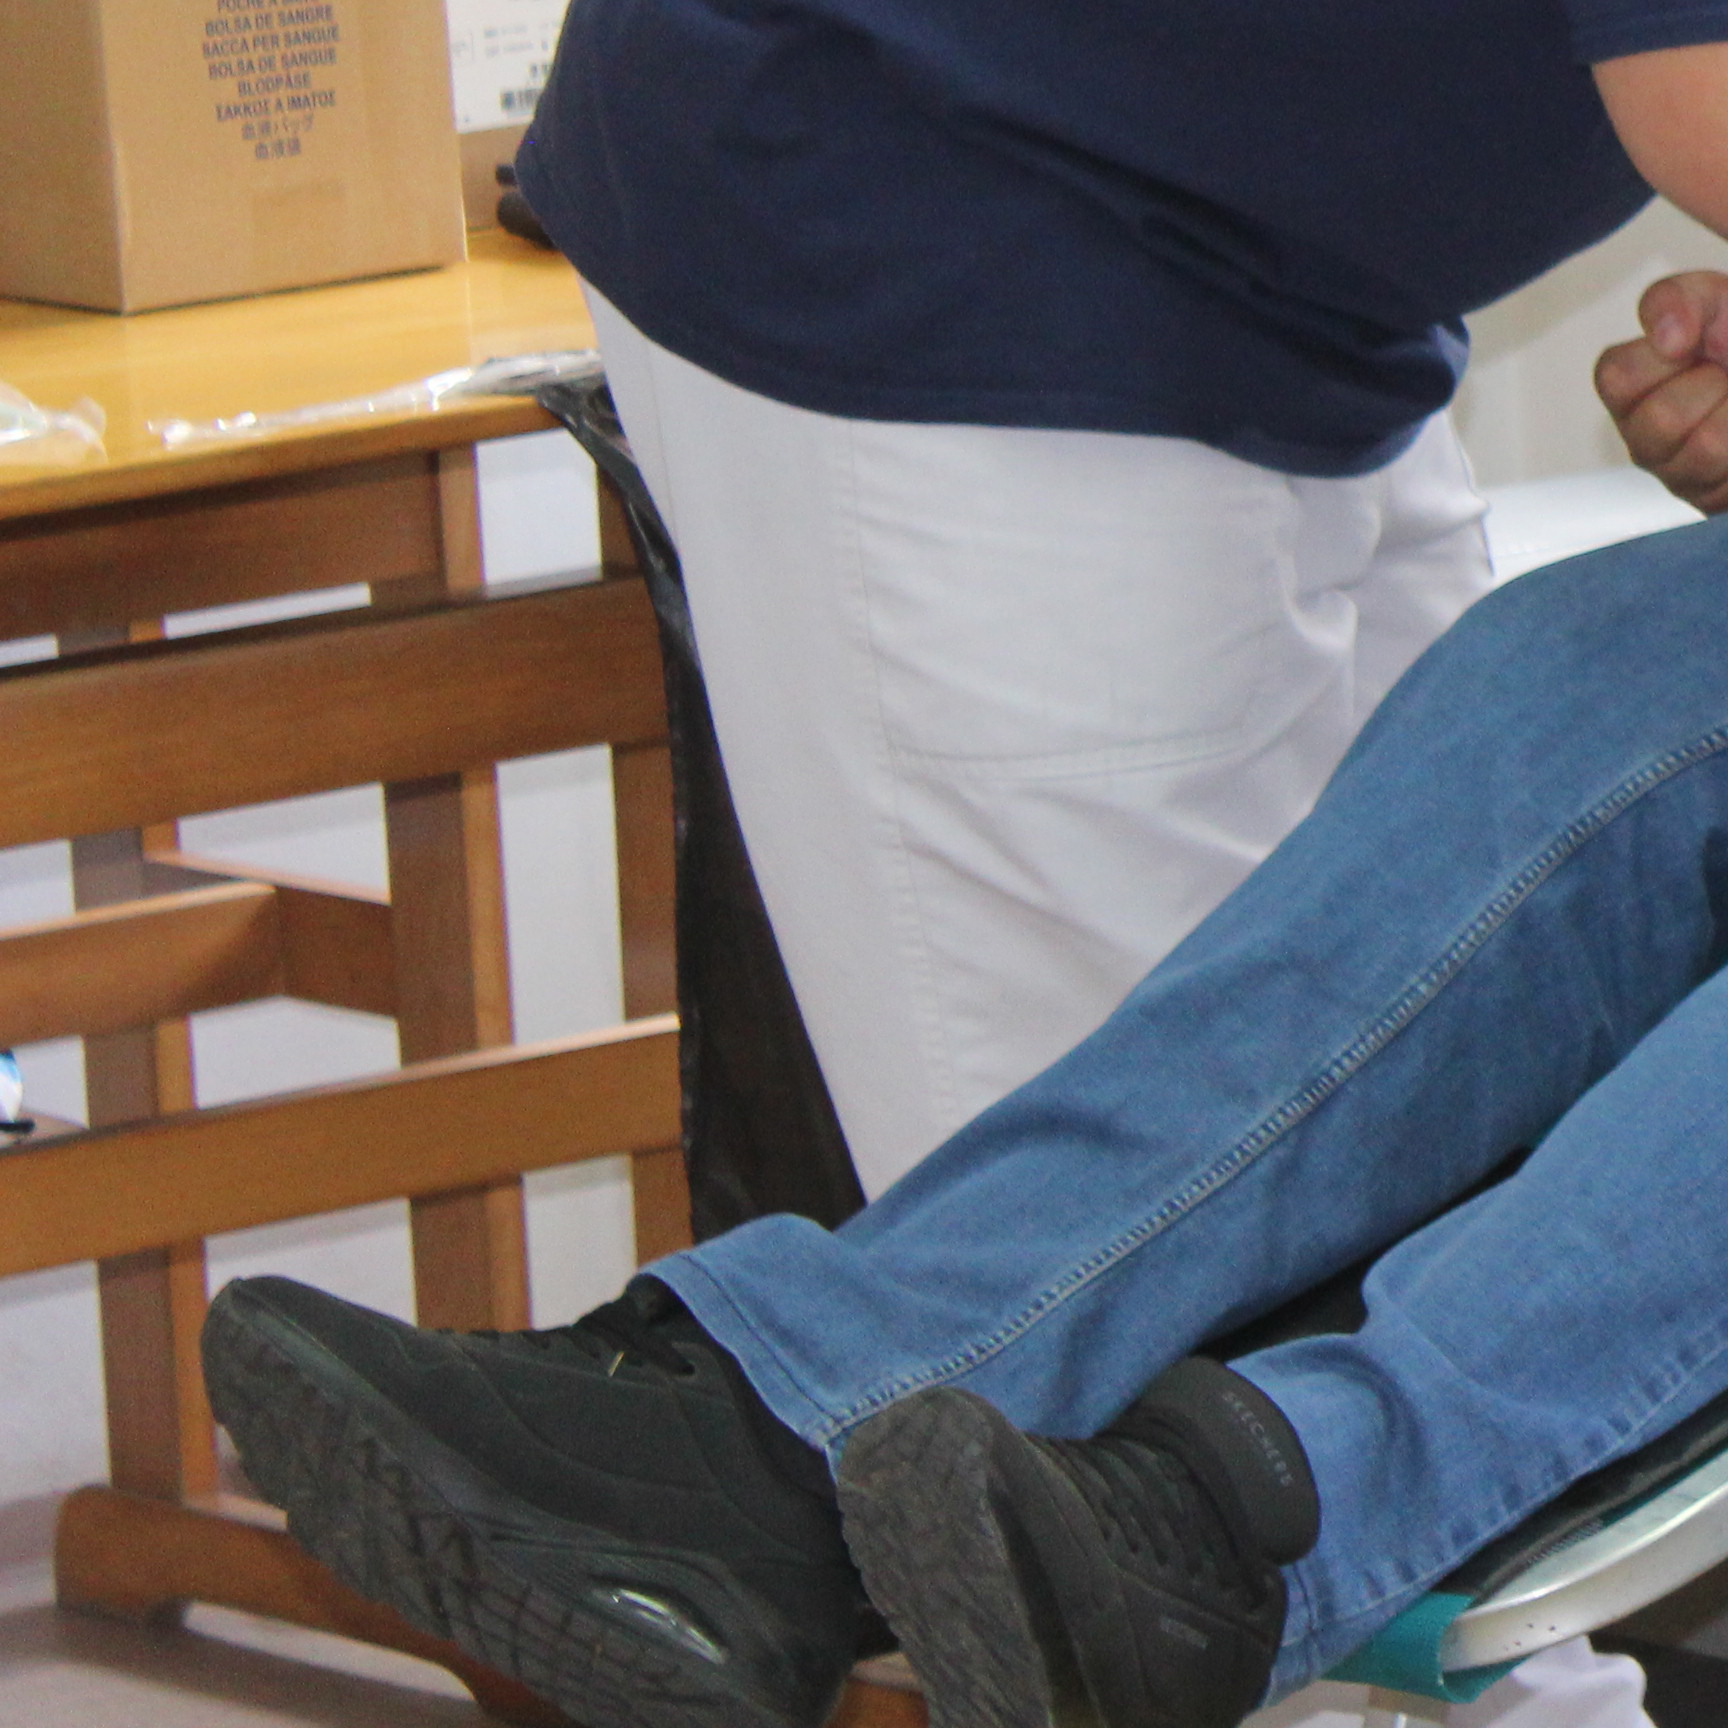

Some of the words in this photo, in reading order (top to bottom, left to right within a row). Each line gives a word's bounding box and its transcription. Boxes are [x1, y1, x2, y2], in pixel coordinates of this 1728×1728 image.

[205, 16, 251, 37] BOLSA
[255, 12, 273, 29] DE
[278, 4, 332, 27] SANGRE
[253, 33, 279, 51] PER
[284, 24, 339, 48] SANGUE
[208, 58, 255, 80] BOLSA
[258, 55, 276, 72] DE
[281, 47, 337, 69] SANGUE
